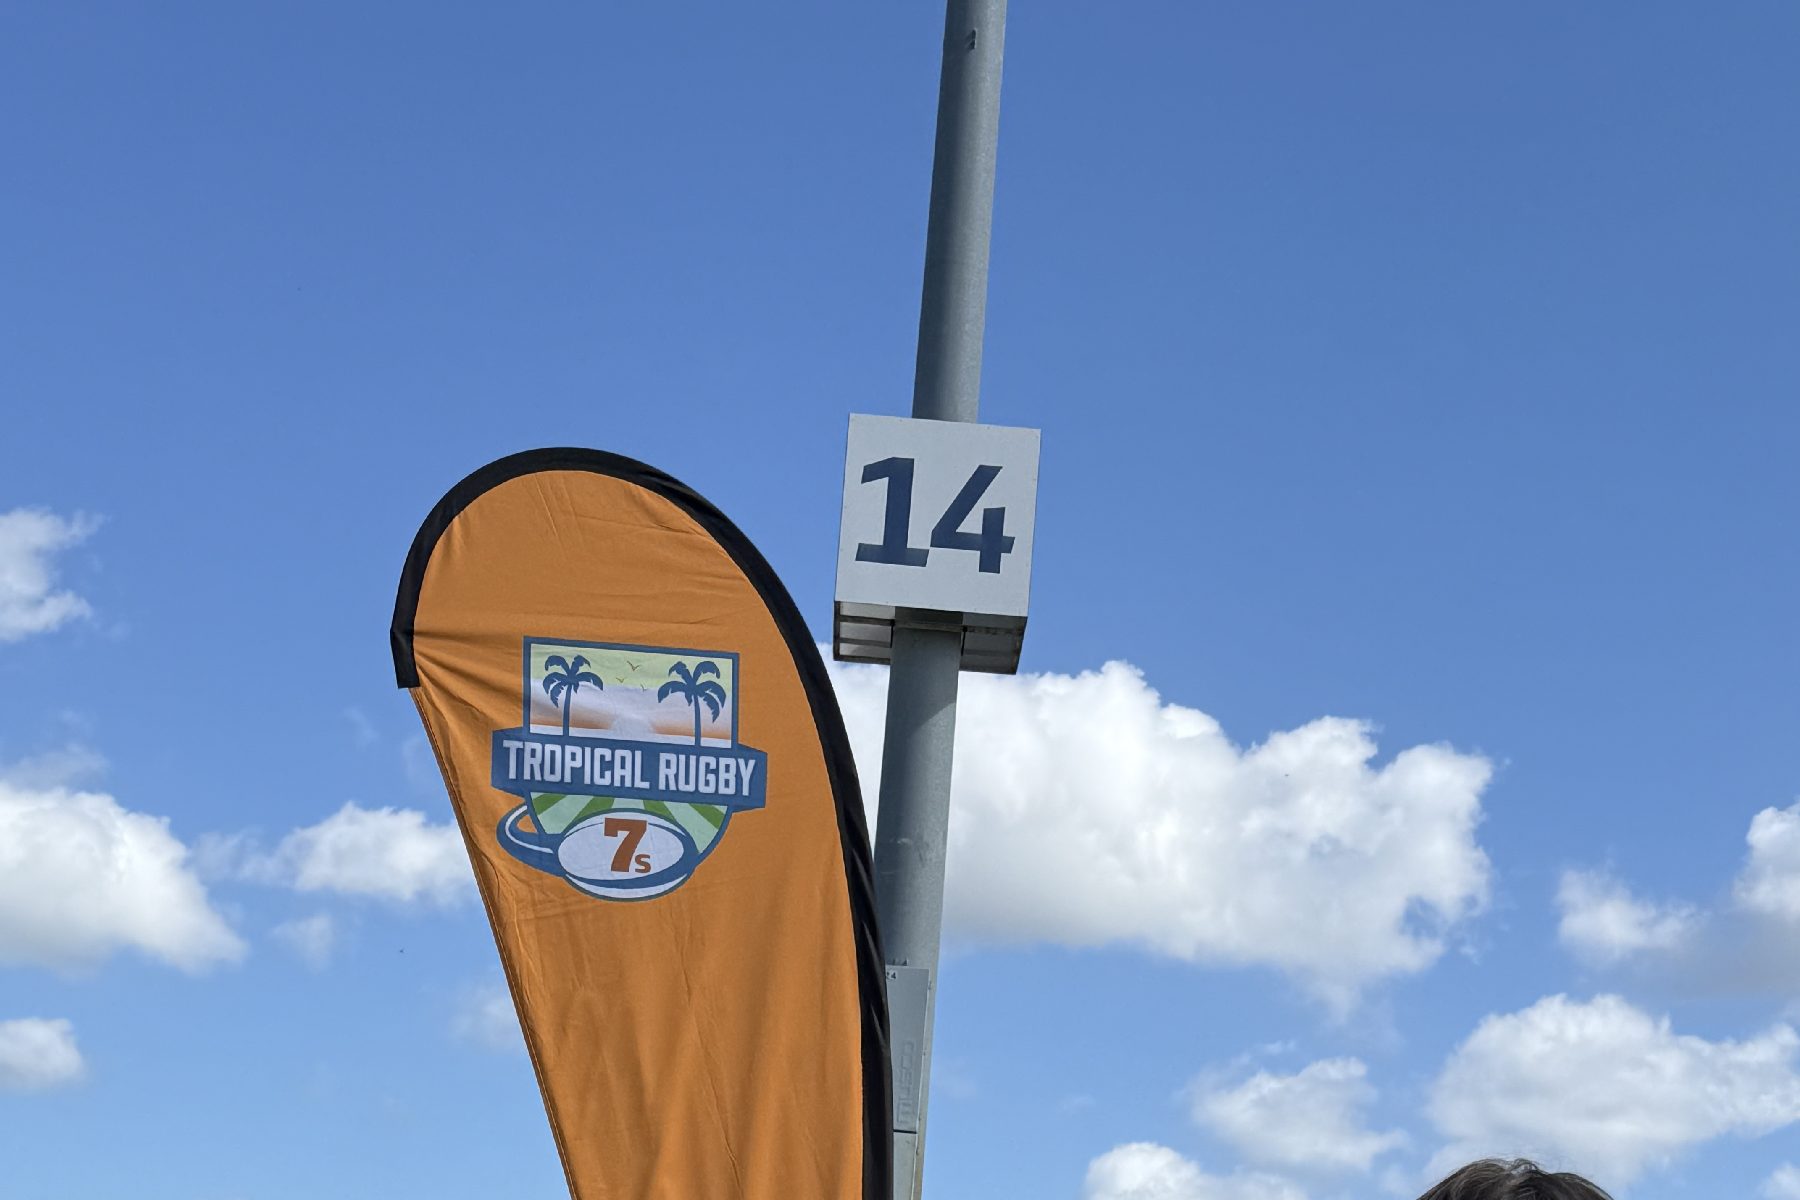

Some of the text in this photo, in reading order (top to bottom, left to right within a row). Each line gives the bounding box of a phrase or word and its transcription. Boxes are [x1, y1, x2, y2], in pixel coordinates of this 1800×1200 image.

[855, 456, 1016, 575] 14
[502, 739, 756, 797] TROPICAL RUGBY
